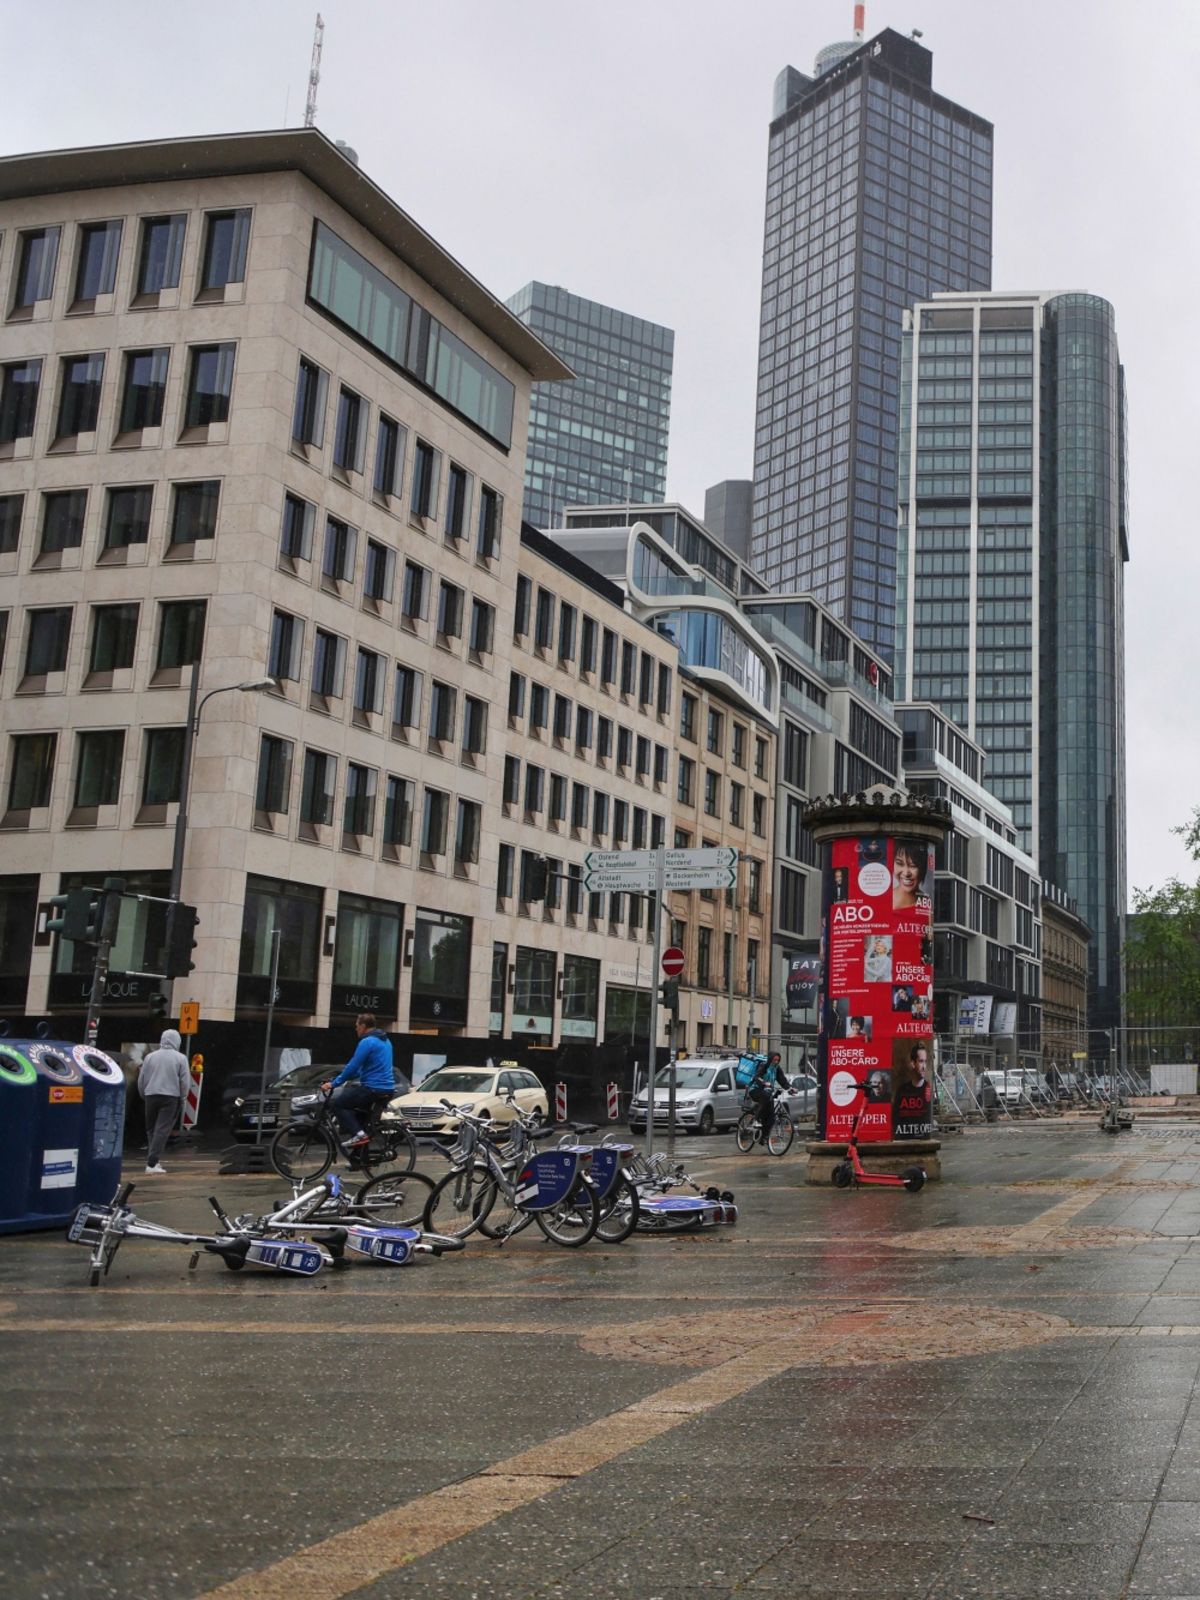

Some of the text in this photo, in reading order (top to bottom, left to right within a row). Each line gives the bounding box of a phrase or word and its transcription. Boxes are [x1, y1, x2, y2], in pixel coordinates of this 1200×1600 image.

[598, 853, 620, 861] Ostend
[665, 851, 685, 859] Gallus
[672, 872, 710, 880] Bockenheim
[665, 880, 691, 888] Westend
[916, 897, 932, 909] ABO
[833, 905, 874, 923] ABO
[896, 922, 920, 933] ALTE
[792, 960, 819, 970] EAT
[896, 965, 925, 975] UNSERE
[82, 982, 139, 998] LIQUE
[346, 993, 380, 1009] LALIQUE
[977, 999, 986, 1028] ITALY
[896, 1023, 920, 1033] ALTE
[831, 1049, 865, 1058] UNSERE
[831, 1057, 879, 1066] ABO-CARD
[899, 1096, 924, 1110] ABO
[830, 1114, 854, 1125] ALTE
[860, 1113, 888, 1125] PER
[895, 1124, 920, 1136] ALTE
